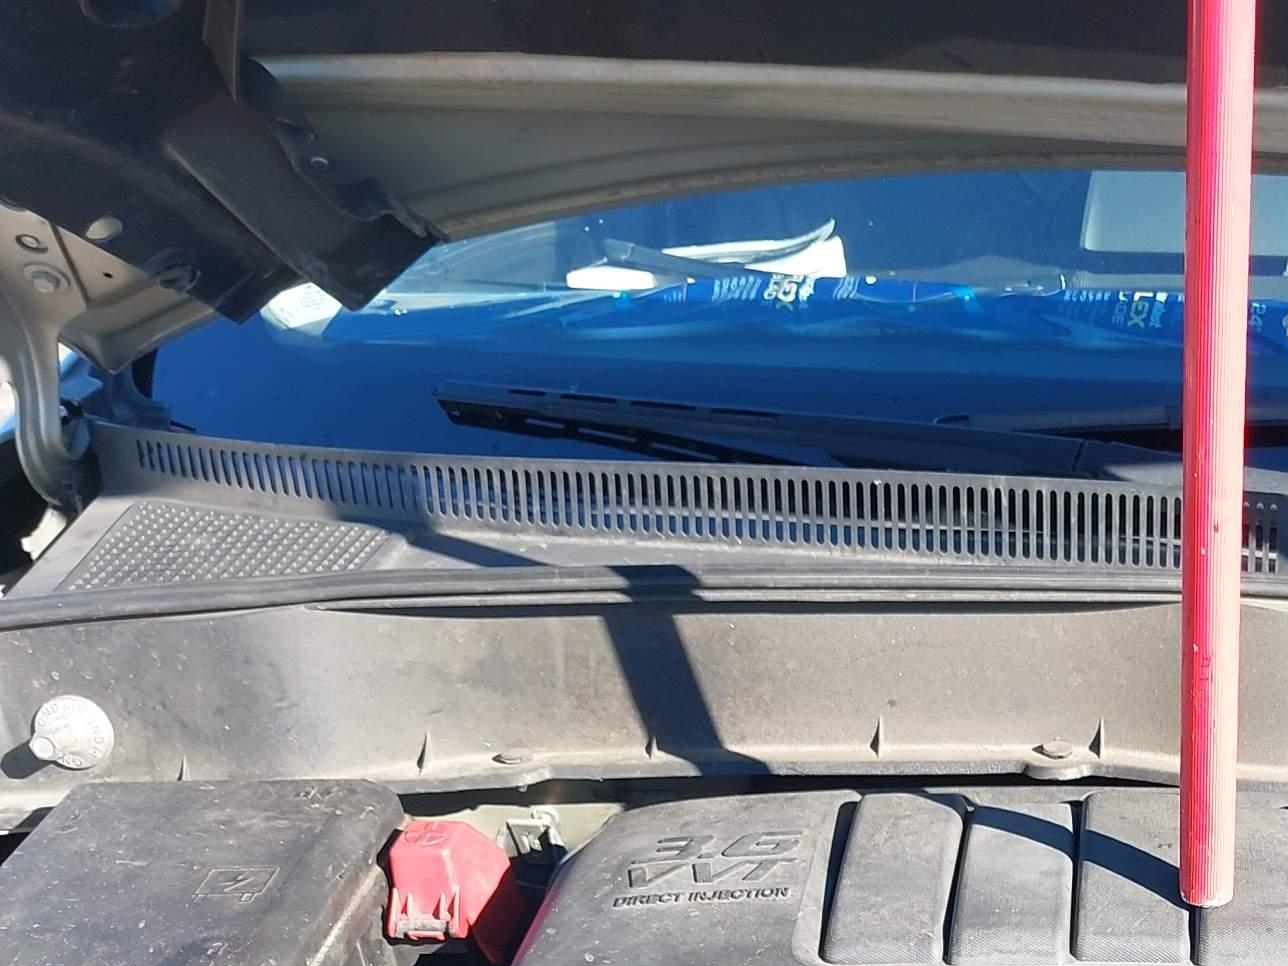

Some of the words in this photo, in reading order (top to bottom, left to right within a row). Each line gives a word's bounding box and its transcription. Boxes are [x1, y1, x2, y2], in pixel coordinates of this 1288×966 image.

[655, 831, 804, 859] 3.6
[627, 855, 798, 888] VVT
[612, 892, 685, 908] DIRECT
[687, 886, 791, 903] INJECTION
